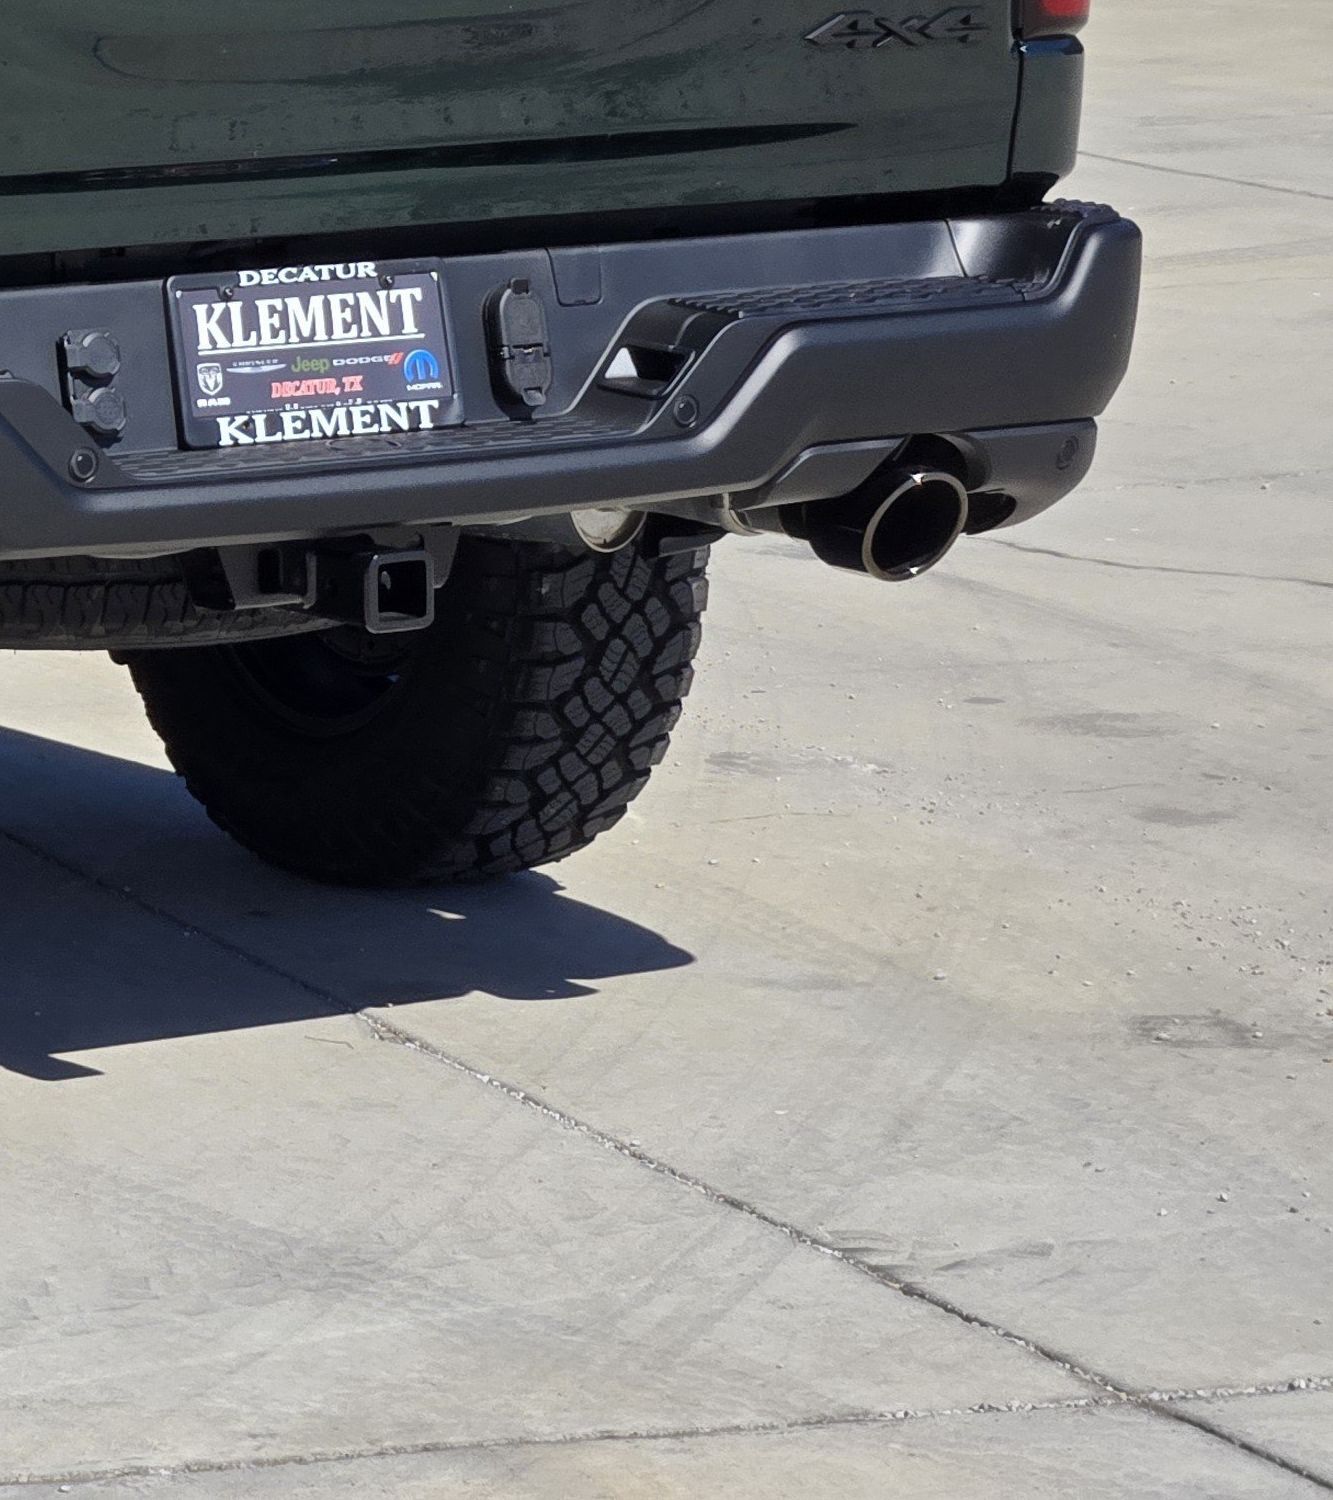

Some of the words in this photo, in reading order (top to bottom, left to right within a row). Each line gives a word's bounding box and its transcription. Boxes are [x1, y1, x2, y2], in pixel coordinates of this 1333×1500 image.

[237, 261, 377, 288] DECATUR
[192, 287, 423, 350] KLEMENT
[291, 355, 330, 374] Jeep
[342, 375, 364, 393] TX
[217, 399, 439, 448] KLEMENT
